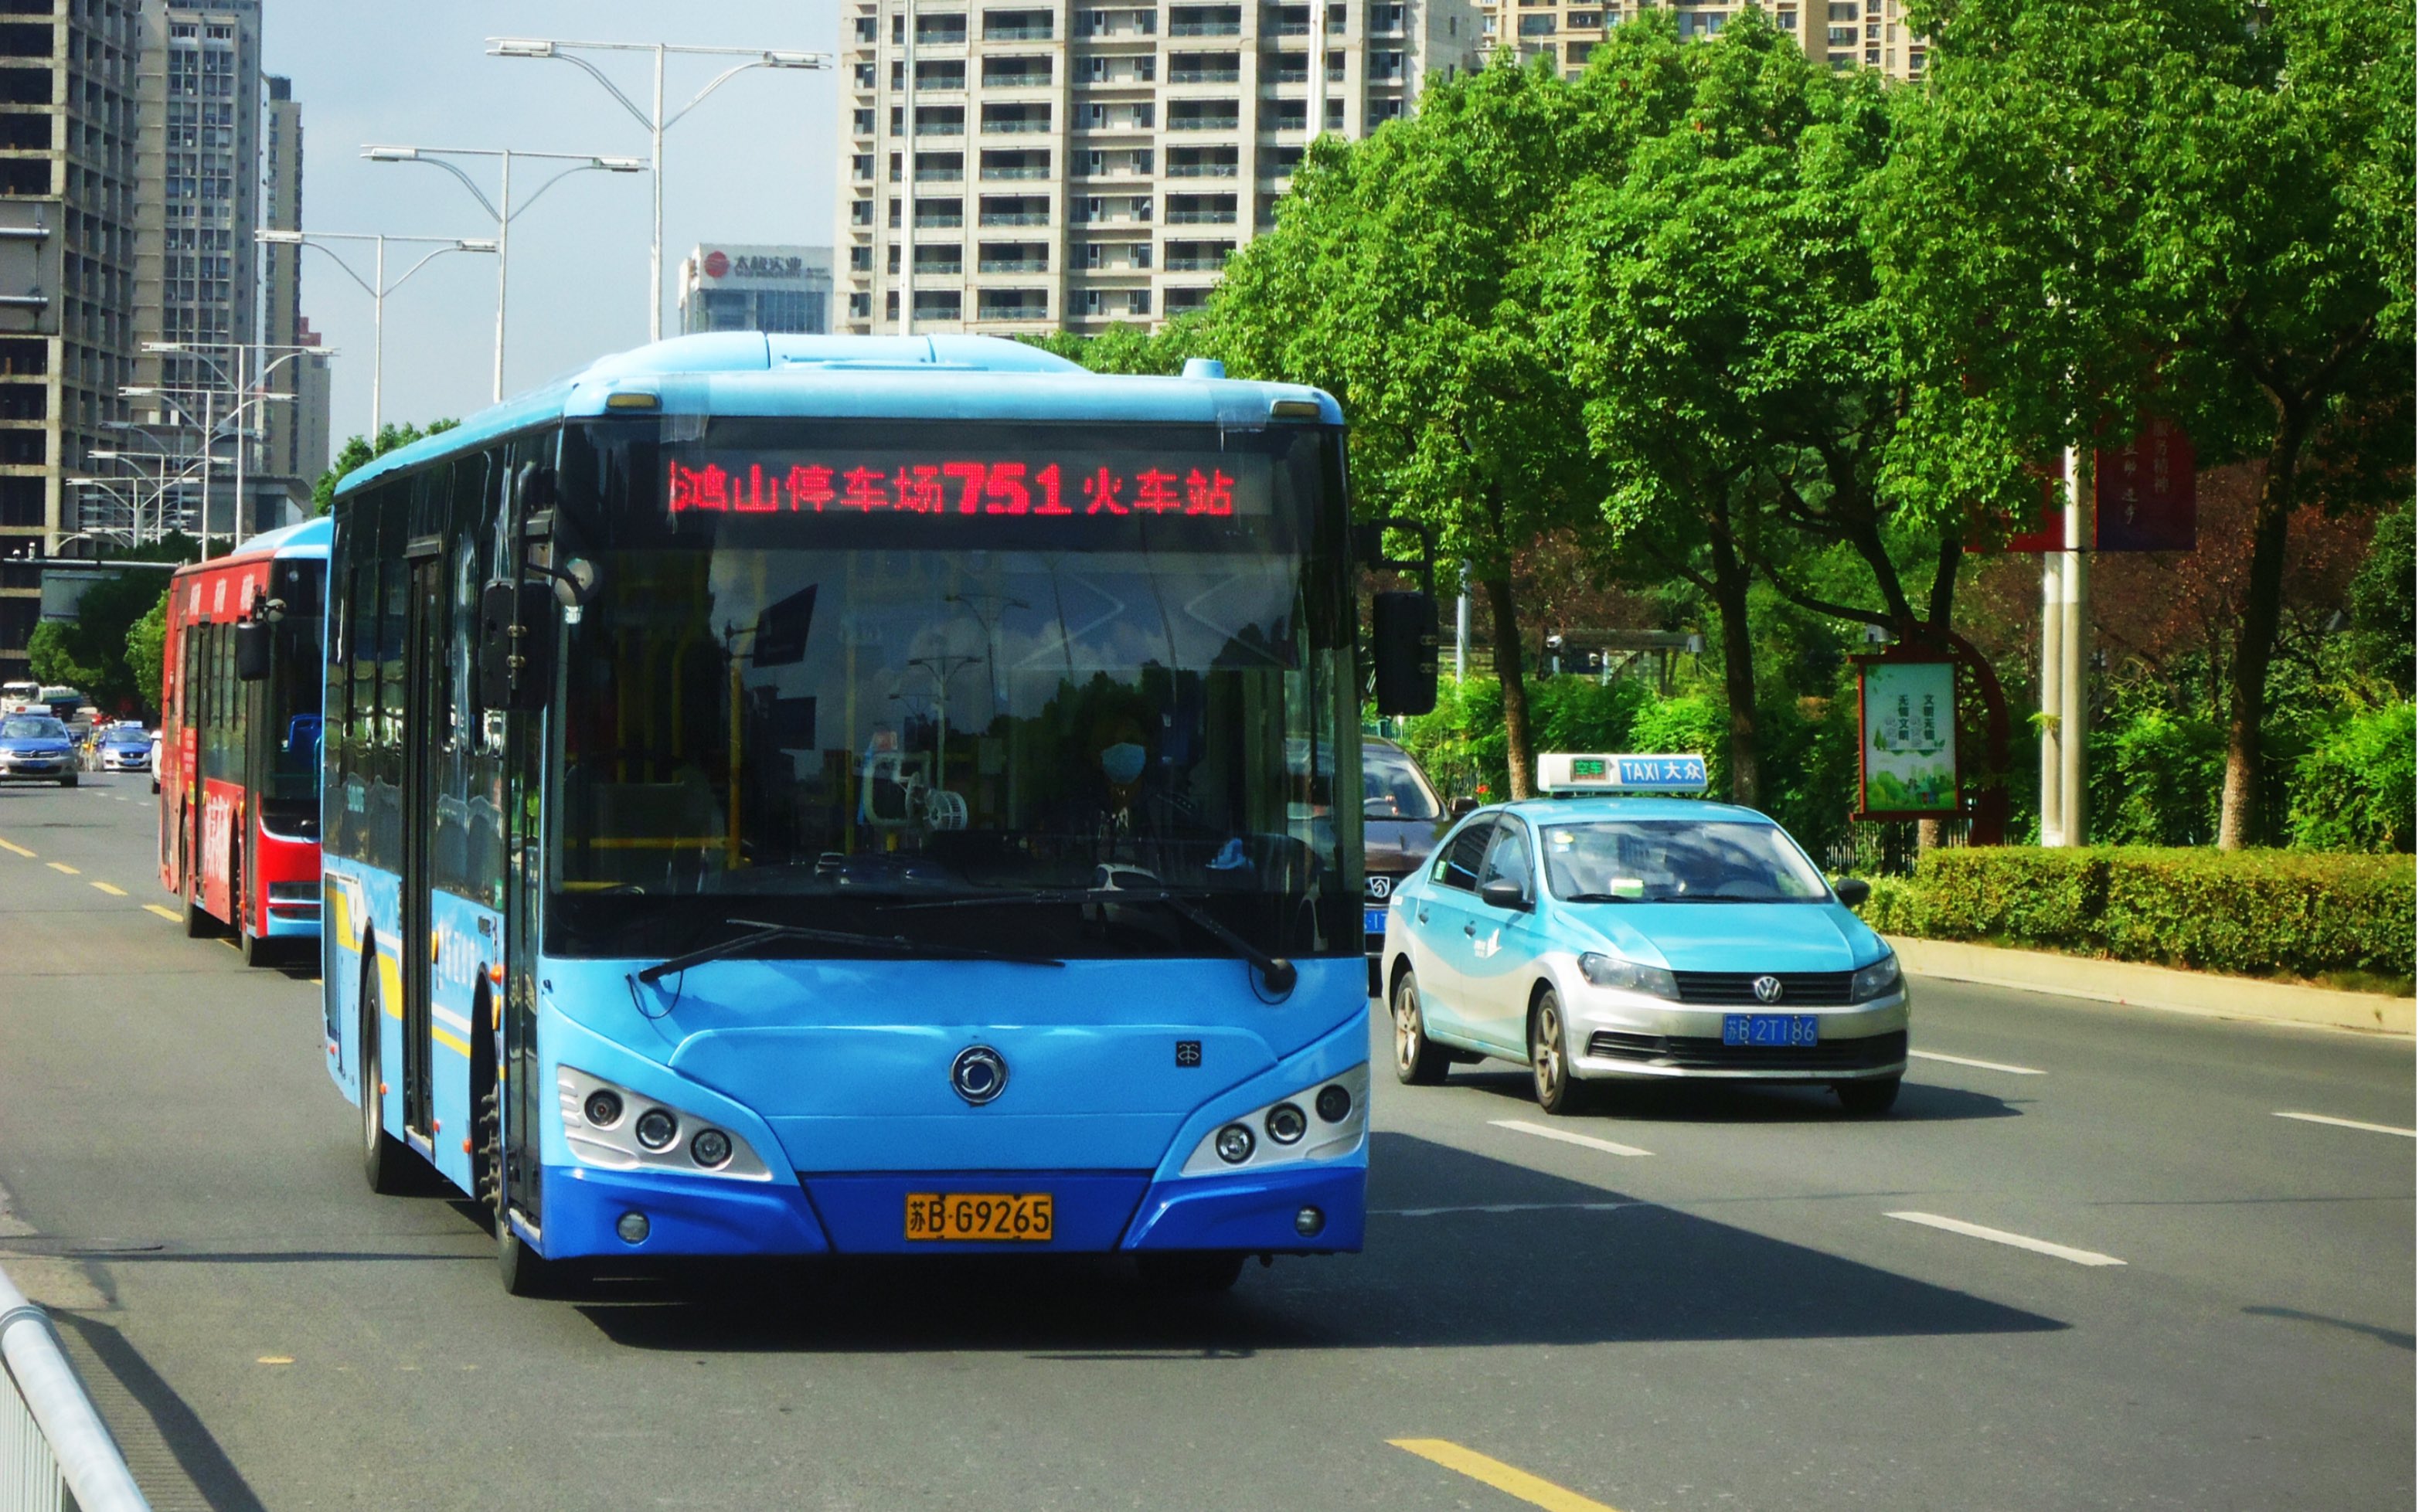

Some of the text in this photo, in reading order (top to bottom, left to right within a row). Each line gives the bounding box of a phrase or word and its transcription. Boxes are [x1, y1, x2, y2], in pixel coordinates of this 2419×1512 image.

[669, 461, 1234, 515] 鸿山停车场 751 火车站
[1575, 761, 1602, 775] 空车
[1623, 762, 1702, 780] TAXI 大众
